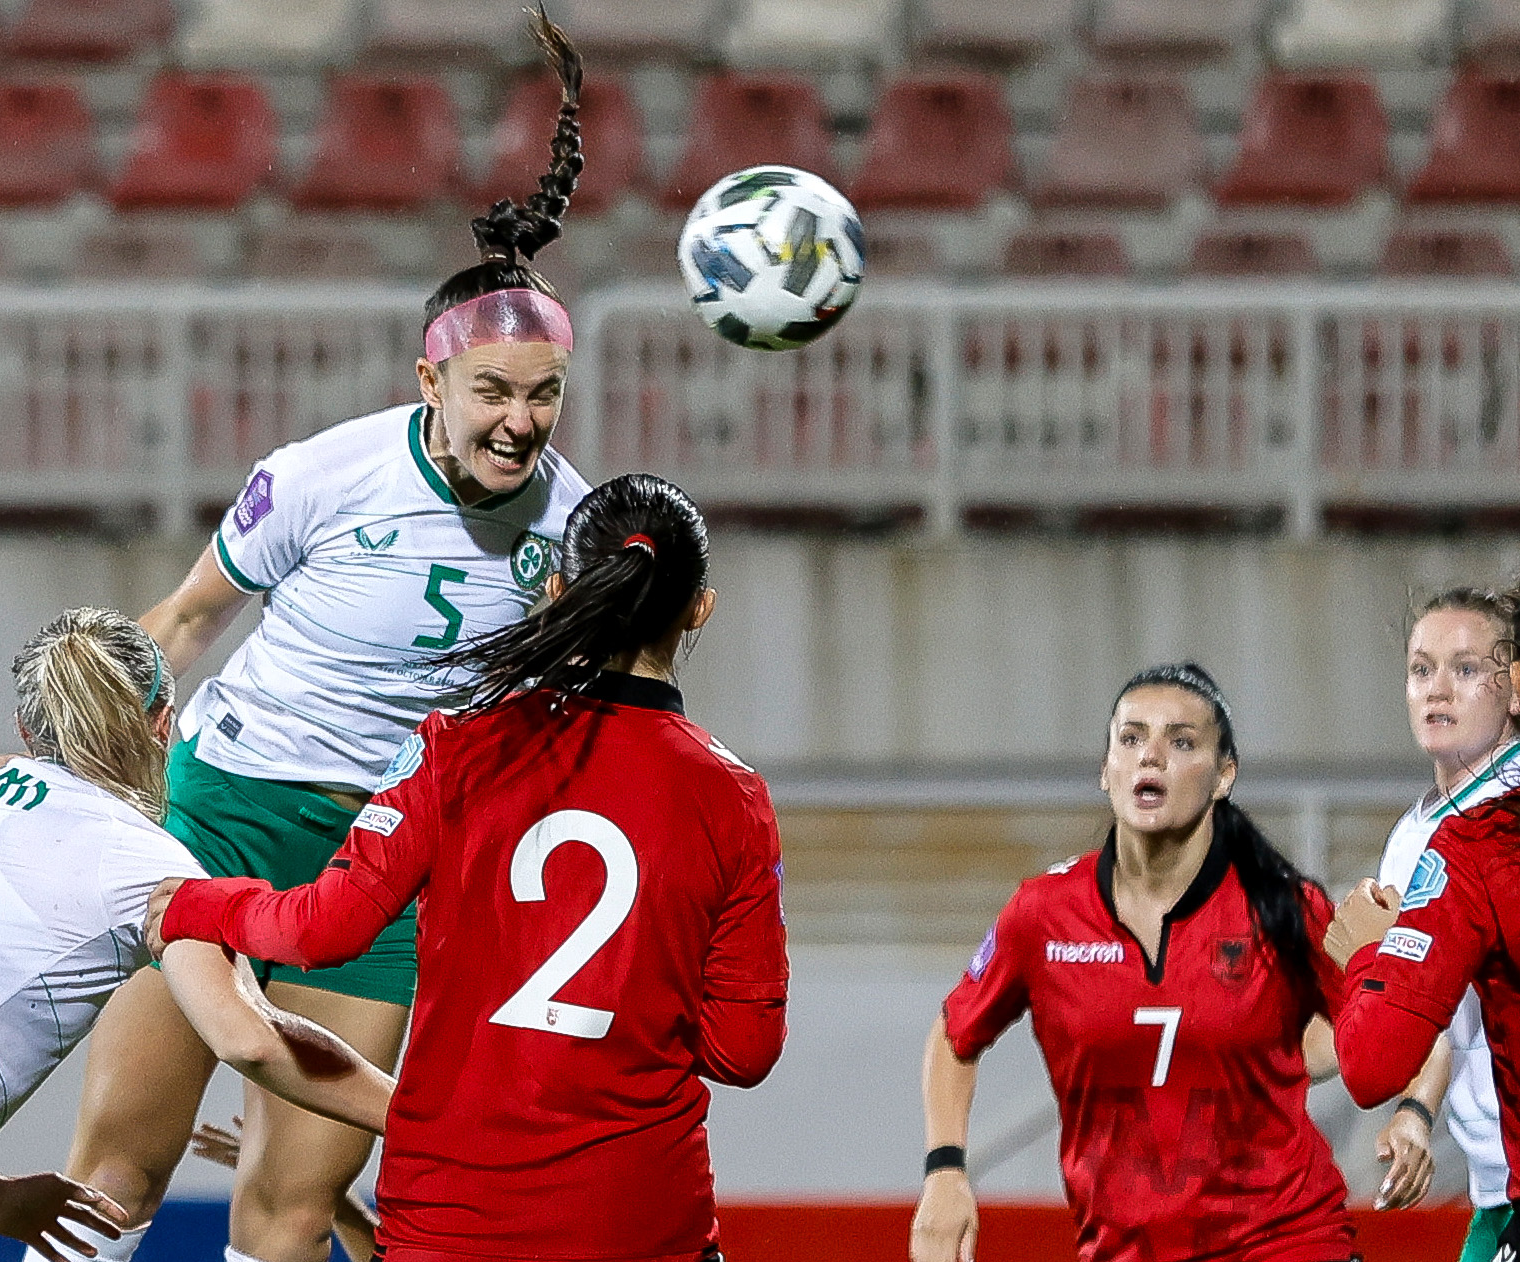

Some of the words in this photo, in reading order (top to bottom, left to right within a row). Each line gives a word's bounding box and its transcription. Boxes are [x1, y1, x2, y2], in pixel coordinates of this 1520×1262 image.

[411, 563, 468, 649] 5
[487, 809, 639, 1039] 2
[1045, 940, 1125, 963] macron
[1134, 1006, 1183, 1087] 7
